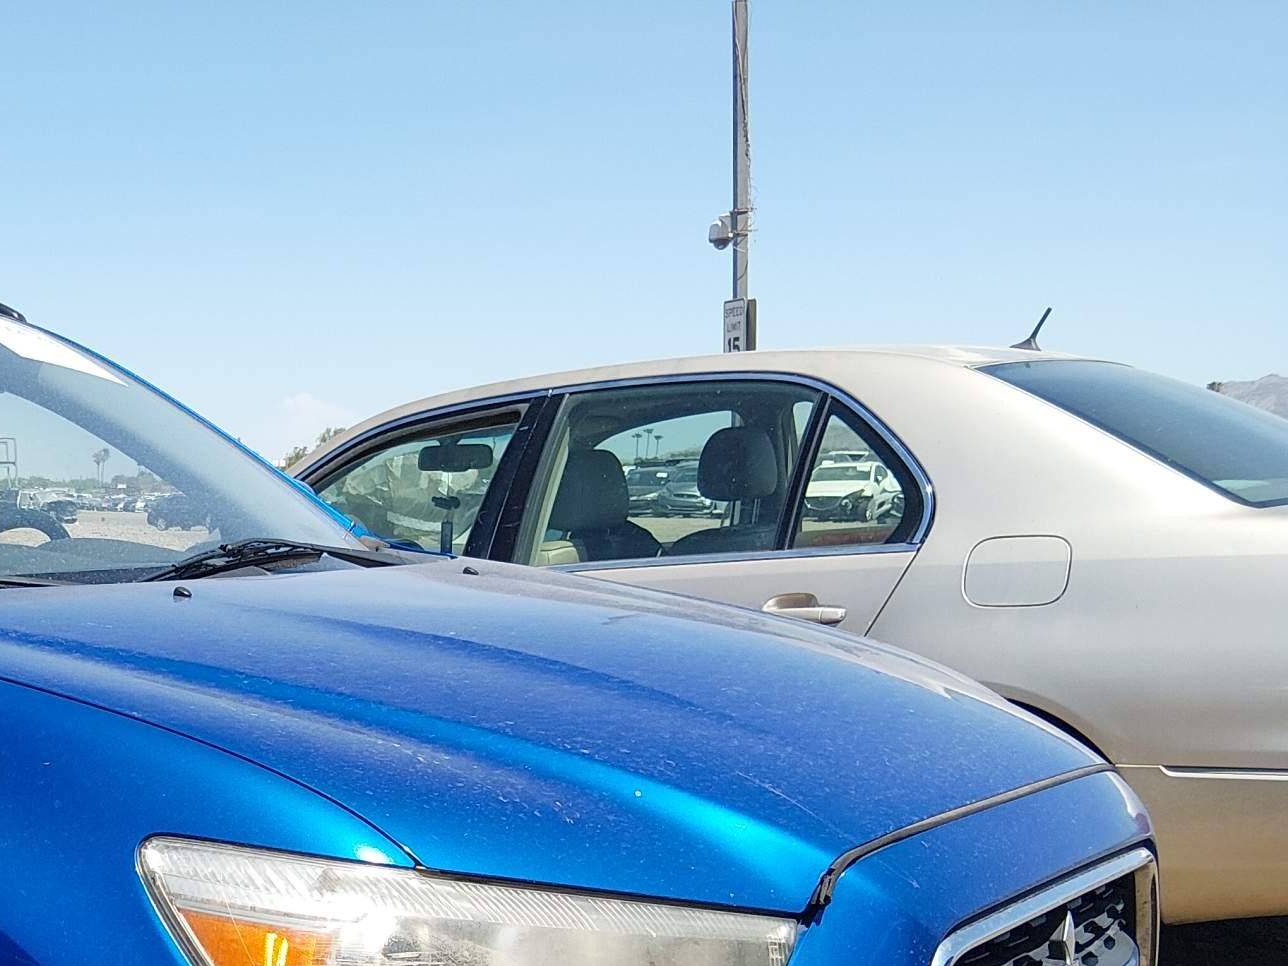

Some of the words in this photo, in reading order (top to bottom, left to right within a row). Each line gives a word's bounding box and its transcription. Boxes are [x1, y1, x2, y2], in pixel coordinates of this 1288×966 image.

[725, 306, 744, 318] SPEED
[727, 320, 742, 333] LIMIT
[727, 336, 741, 352] 15
